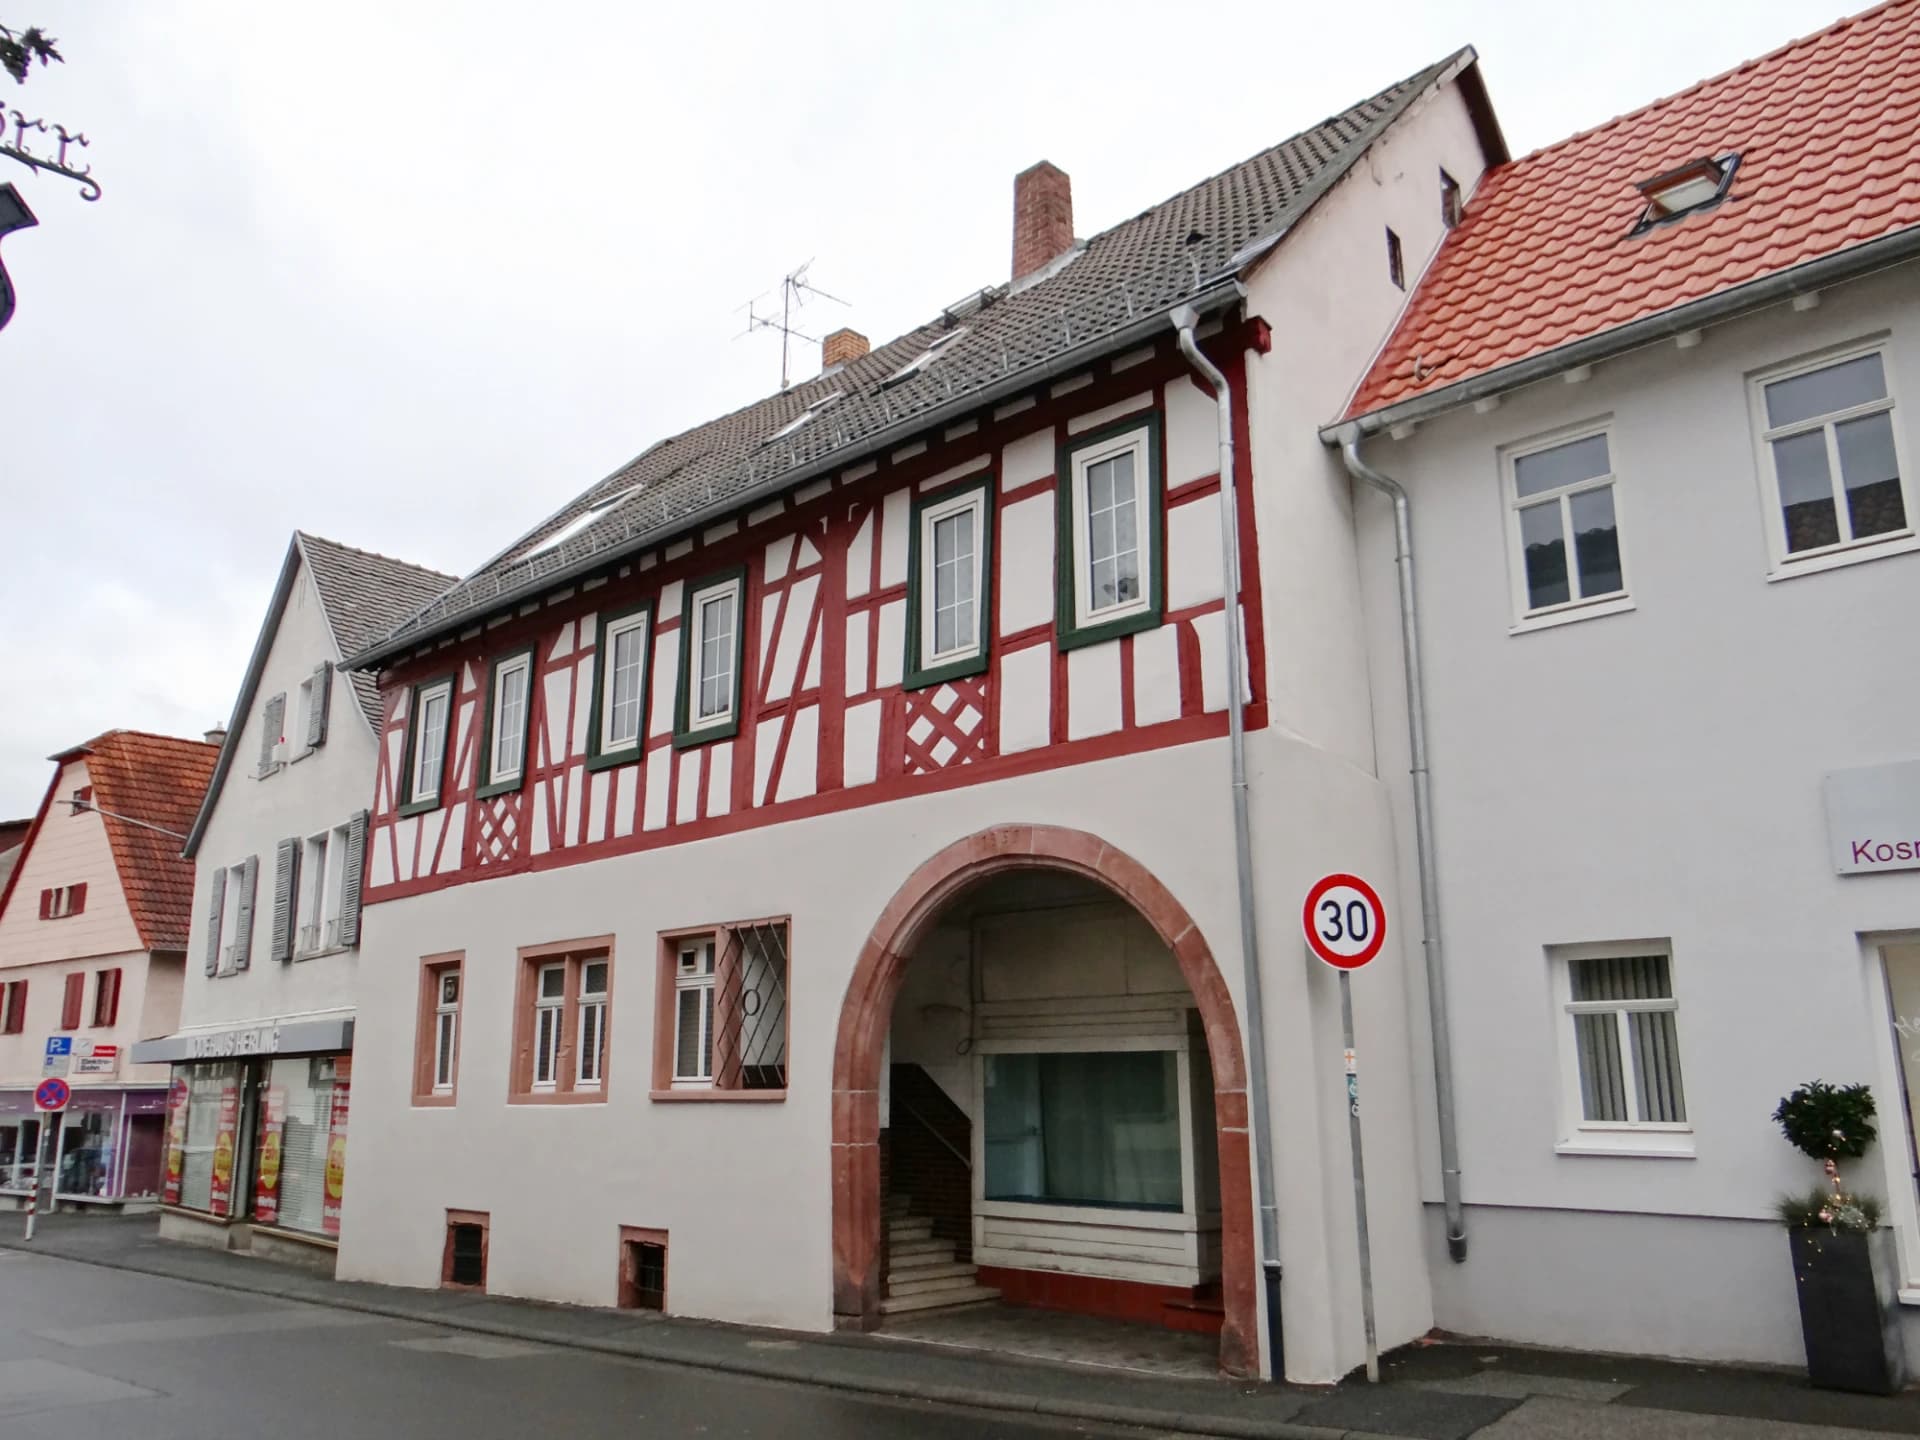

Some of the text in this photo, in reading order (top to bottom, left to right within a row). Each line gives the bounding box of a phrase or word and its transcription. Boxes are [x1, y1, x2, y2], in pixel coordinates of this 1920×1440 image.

[1851, 839, 1920, 864] Kos
[1321, 900, 1368, 942] 30
[49, 1039, 62, 1053] P
